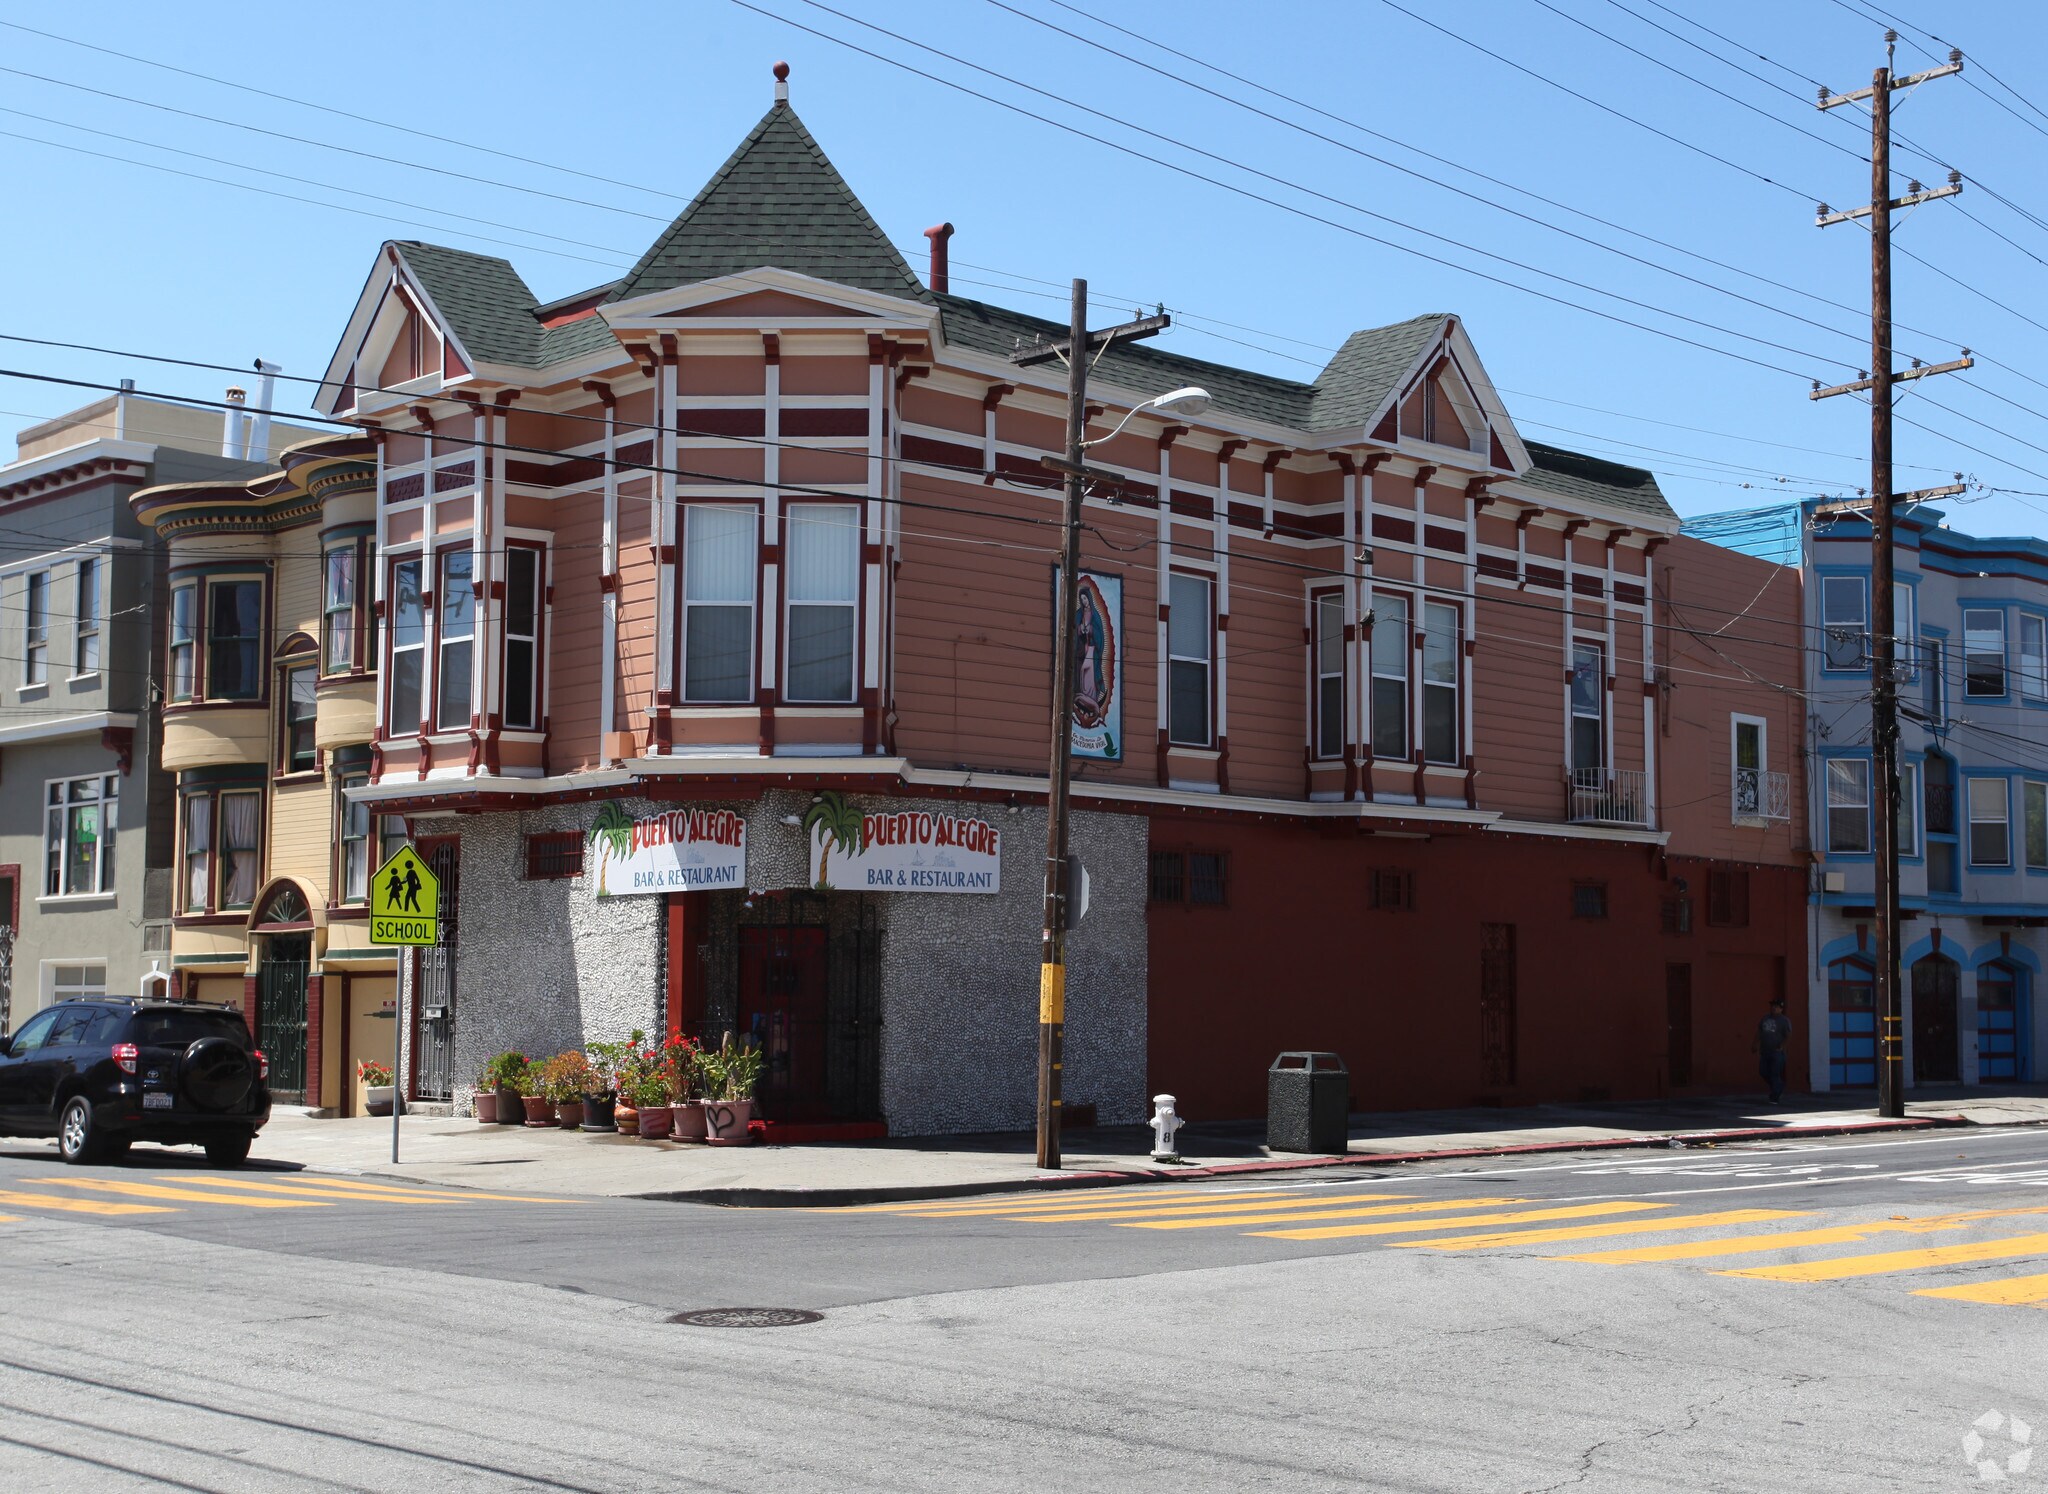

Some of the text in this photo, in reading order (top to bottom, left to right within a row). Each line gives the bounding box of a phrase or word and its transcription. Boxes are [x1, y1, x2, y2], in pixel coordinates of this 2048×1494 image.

[632, 809, 744, 853] PUERTO ALEGRE
[862, 812, 999, 856] PUERTO ALEGRE
[634, 865, 739, 888] BAR & RESTAURANT
[867, 868, 993, 888] BAR & RESTAURANT
[376, 921, 432, 940] SCHOOL
[1163, 1131, 1171, 1143] 8
